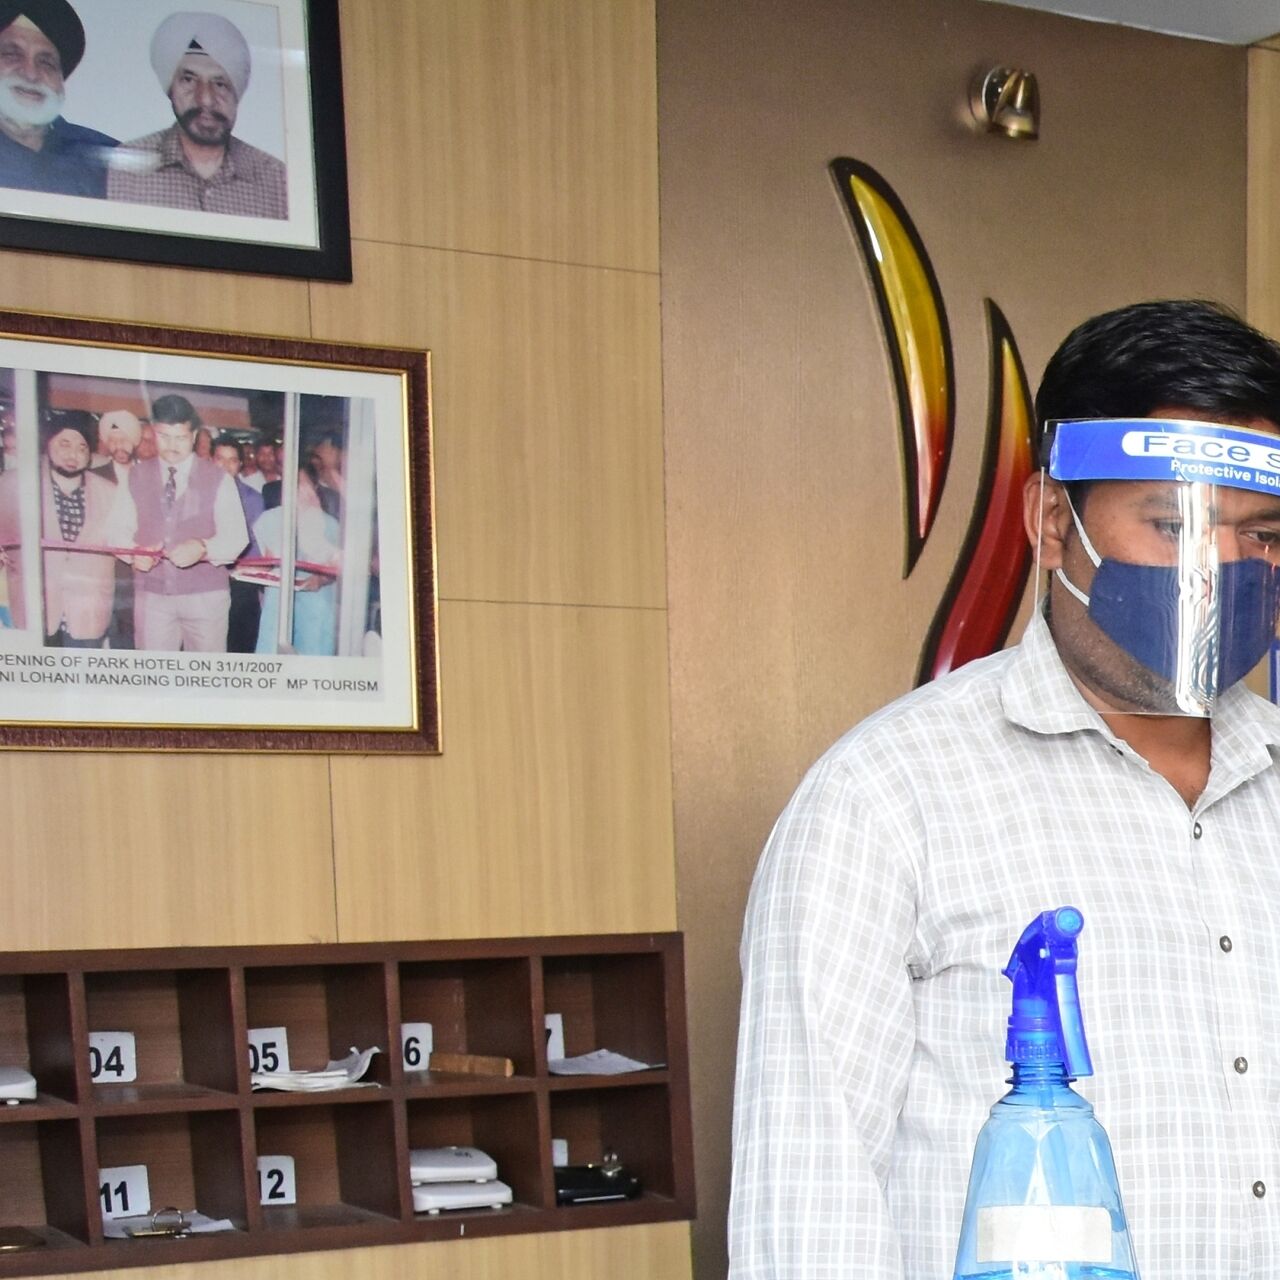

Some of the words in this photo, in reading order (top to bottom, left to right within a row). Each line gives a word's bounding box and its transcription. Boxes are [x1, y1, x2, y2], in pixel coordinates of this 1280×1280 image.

[1143, 435, 1251, 462] Face
[1171, 459, 1251, 482] Protective
[60, 656, 82, 668] OF
[88, 657, 129, 670] PARK
[134, 658, 185, 671] HOTEL
[189, 660, 211, 671] ON
[216, 660, 283, 673] 31/1/2007
[20, 671, 80, 684] LOHANI
[85, 673, 170, 687] MANAGING
[175, 675, 253, 688] DIRECTOR
[257, 677, 277, 688] OF
[287, 678, 308, 690] MP
[312, 679, 378, 691] TOURISM
